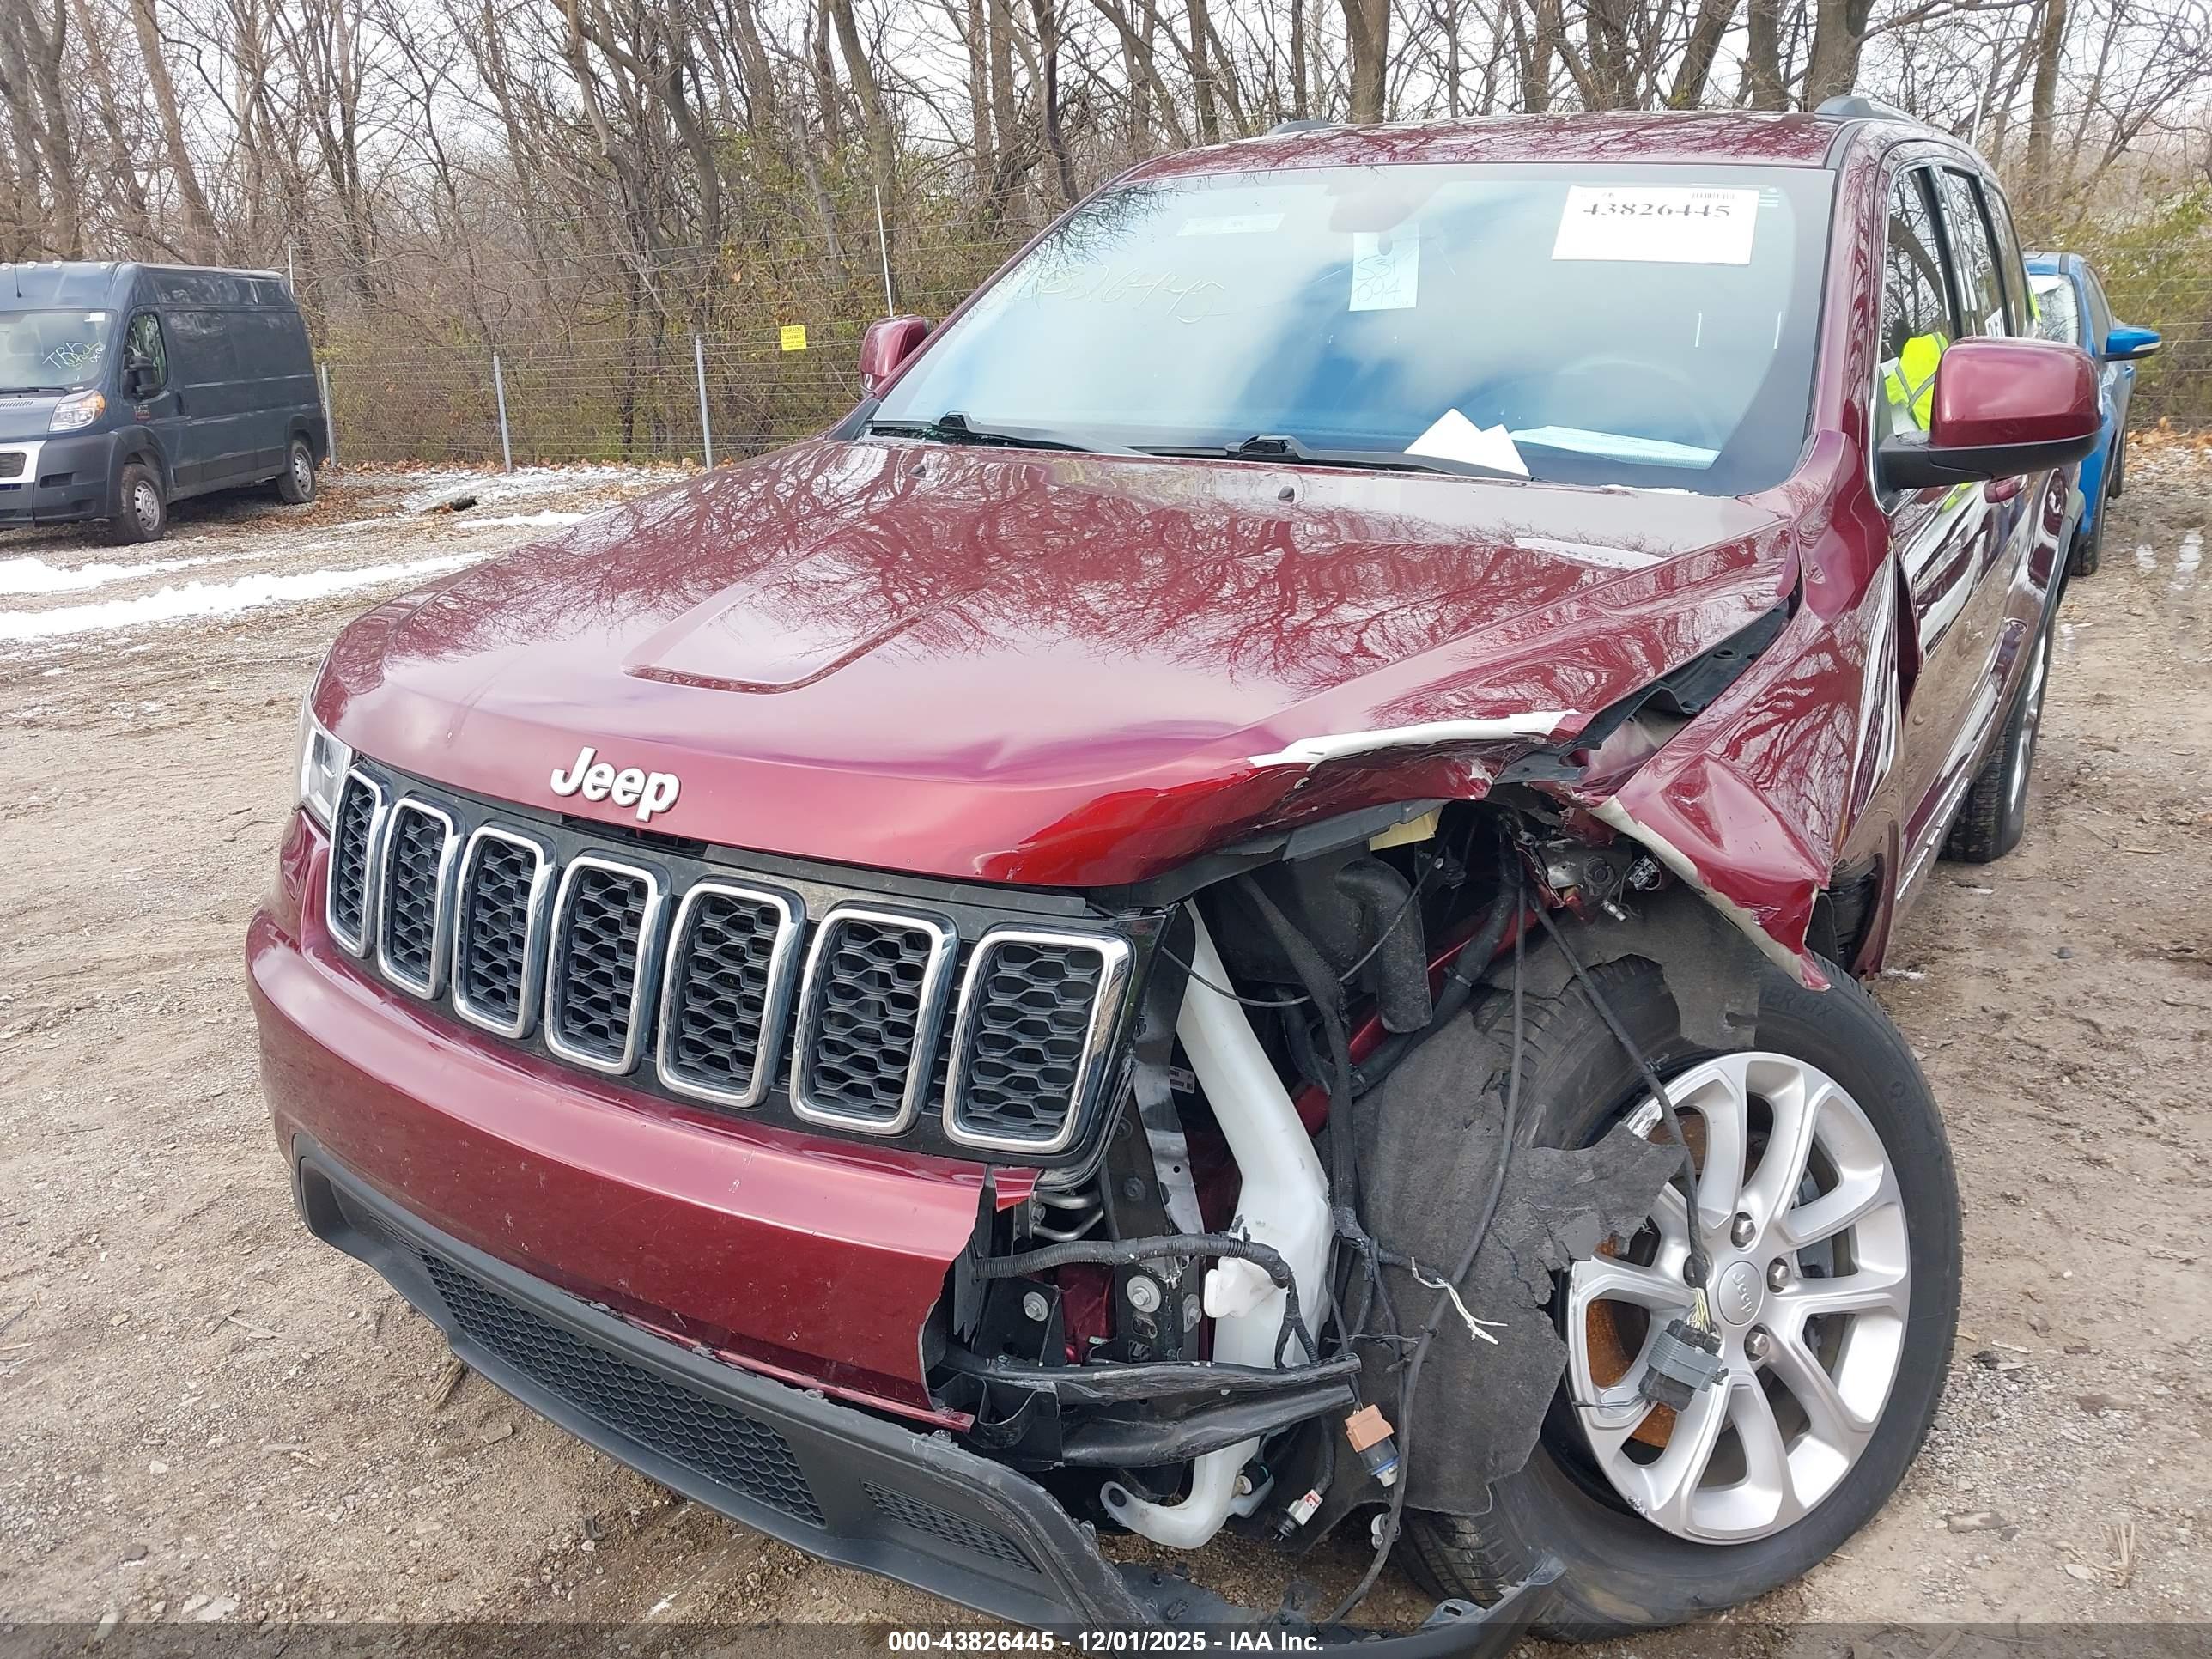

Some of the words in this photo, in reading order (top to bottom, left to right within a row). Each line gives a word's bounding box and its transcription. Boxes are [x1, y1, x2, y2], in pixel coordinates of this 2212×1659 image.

[1583, 203, 1731, 218] 43826445
[550, 746, 682, 823] Jeep
[1731, 1271, 1753, 1315] Jeep
